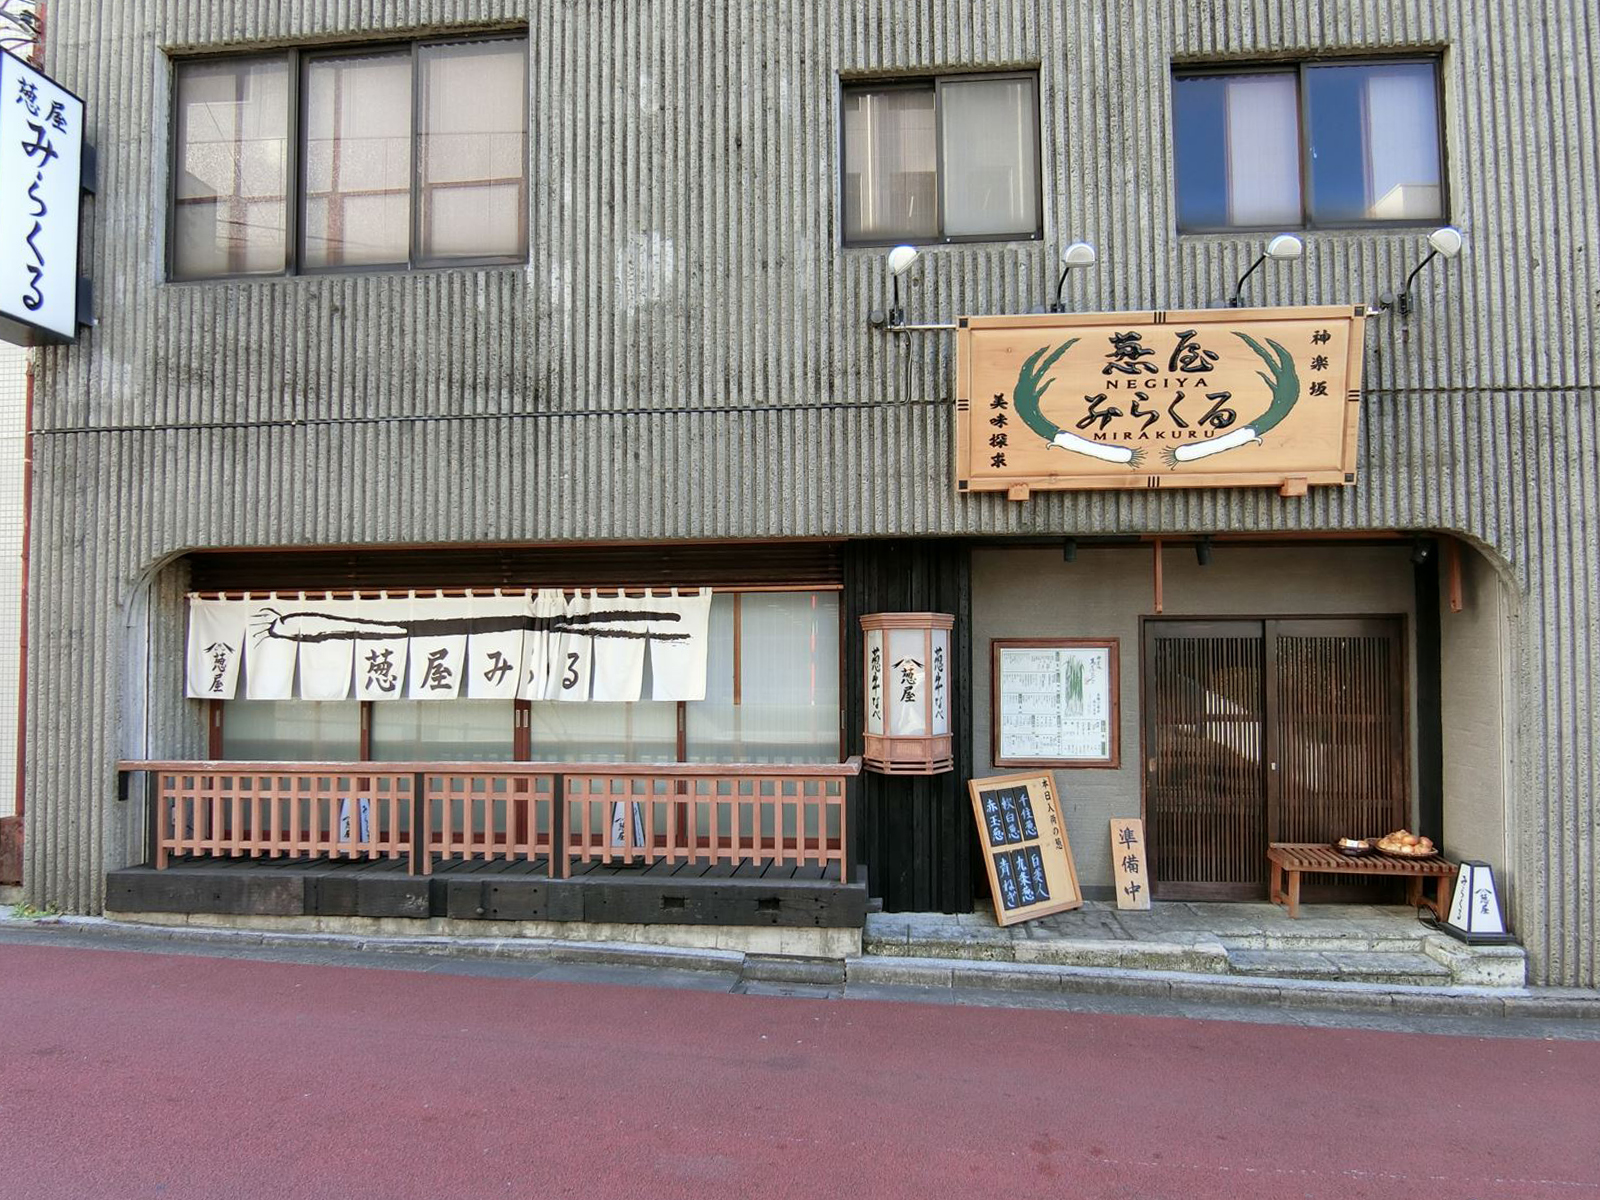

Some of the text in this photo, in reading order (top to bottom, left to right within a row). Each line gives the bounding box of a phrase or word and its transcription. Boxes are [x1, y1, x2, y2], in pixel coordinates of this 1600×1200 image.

[16, 76, 68, 135] 葱屋
[21, 119, 60, 311] みらくる
[1101, 329, 1219, 375] 葱屋
[1308, 329, 1332, 397] 神楽坂
[1106, 378, 1210, 391] NEGIYA
[988, 393, 1010, 469] 美味探求
[1075, 390, 1238, 430] みらくる
[1093, 429, 1217, 442] MIRAKURU
[207, 652, 227, 693] 葱屋
[900, 667, 916, 703] 葱屋
[1118, 826, 1142, 903] 準備中
